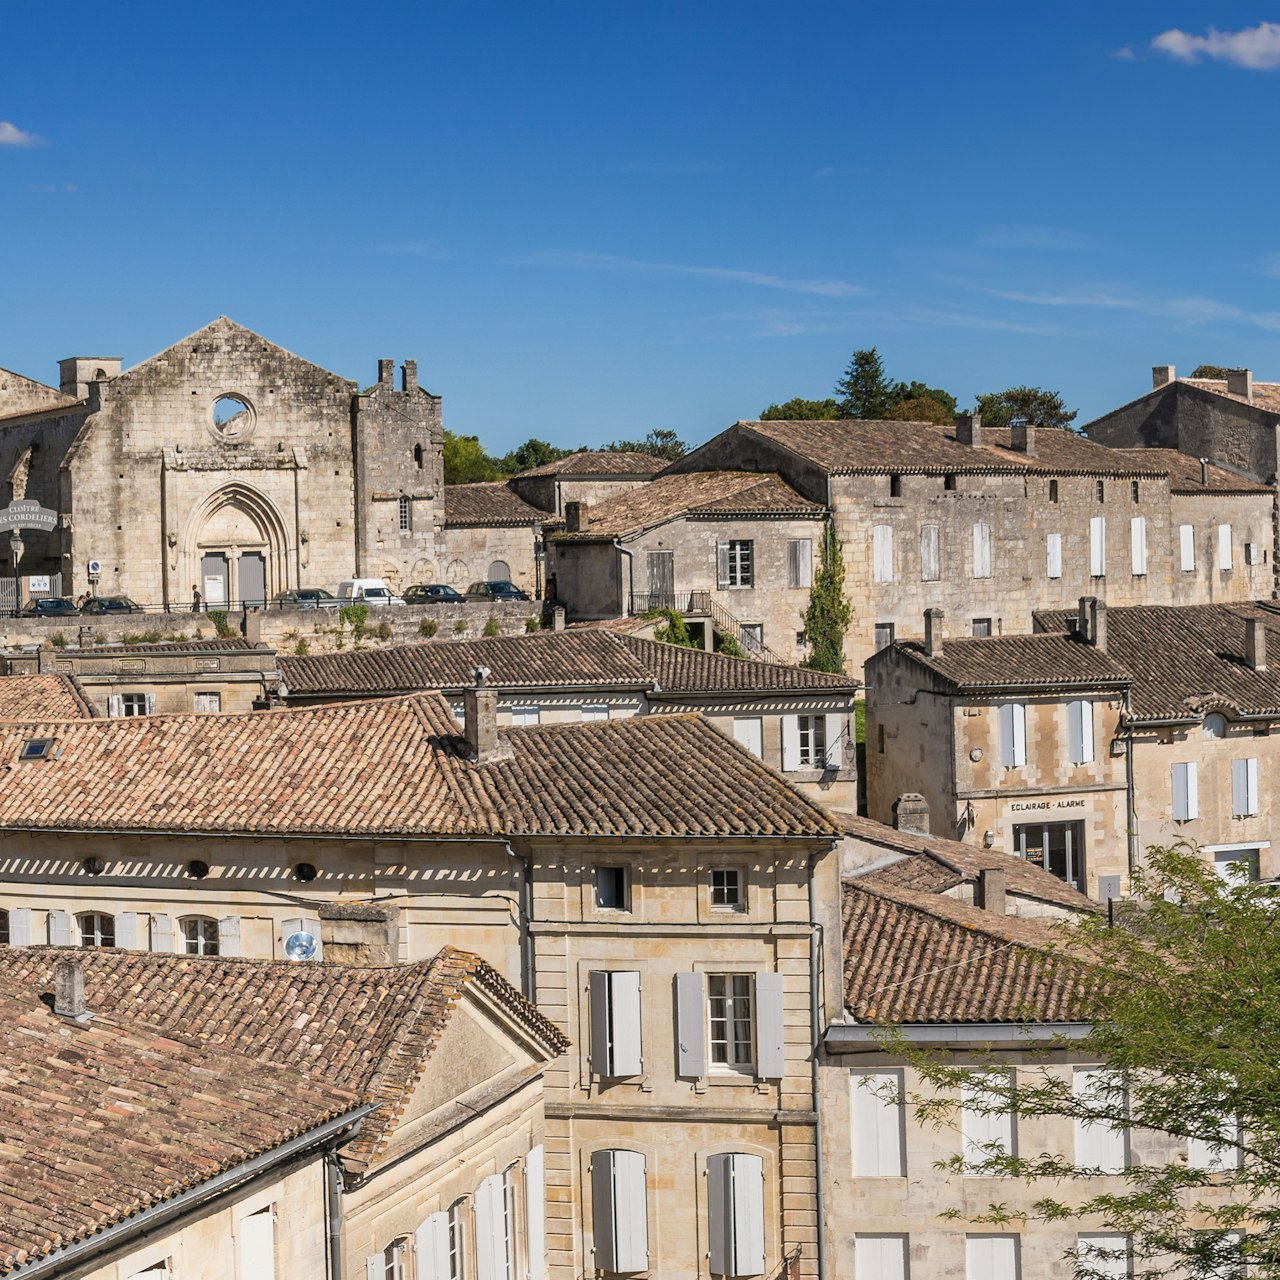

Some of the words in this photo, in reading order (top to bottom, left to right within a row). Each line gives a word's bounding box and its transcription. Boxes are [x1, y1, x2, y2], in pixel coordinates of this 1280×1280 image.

[9, 505, 40, 513] CLOÎTRE
[8, 513, 57, 524] CORDELIERS
[1011, 802, 1051, 811] ECLAIRAGE
[1057, 799, 1086, 809] ALARME
